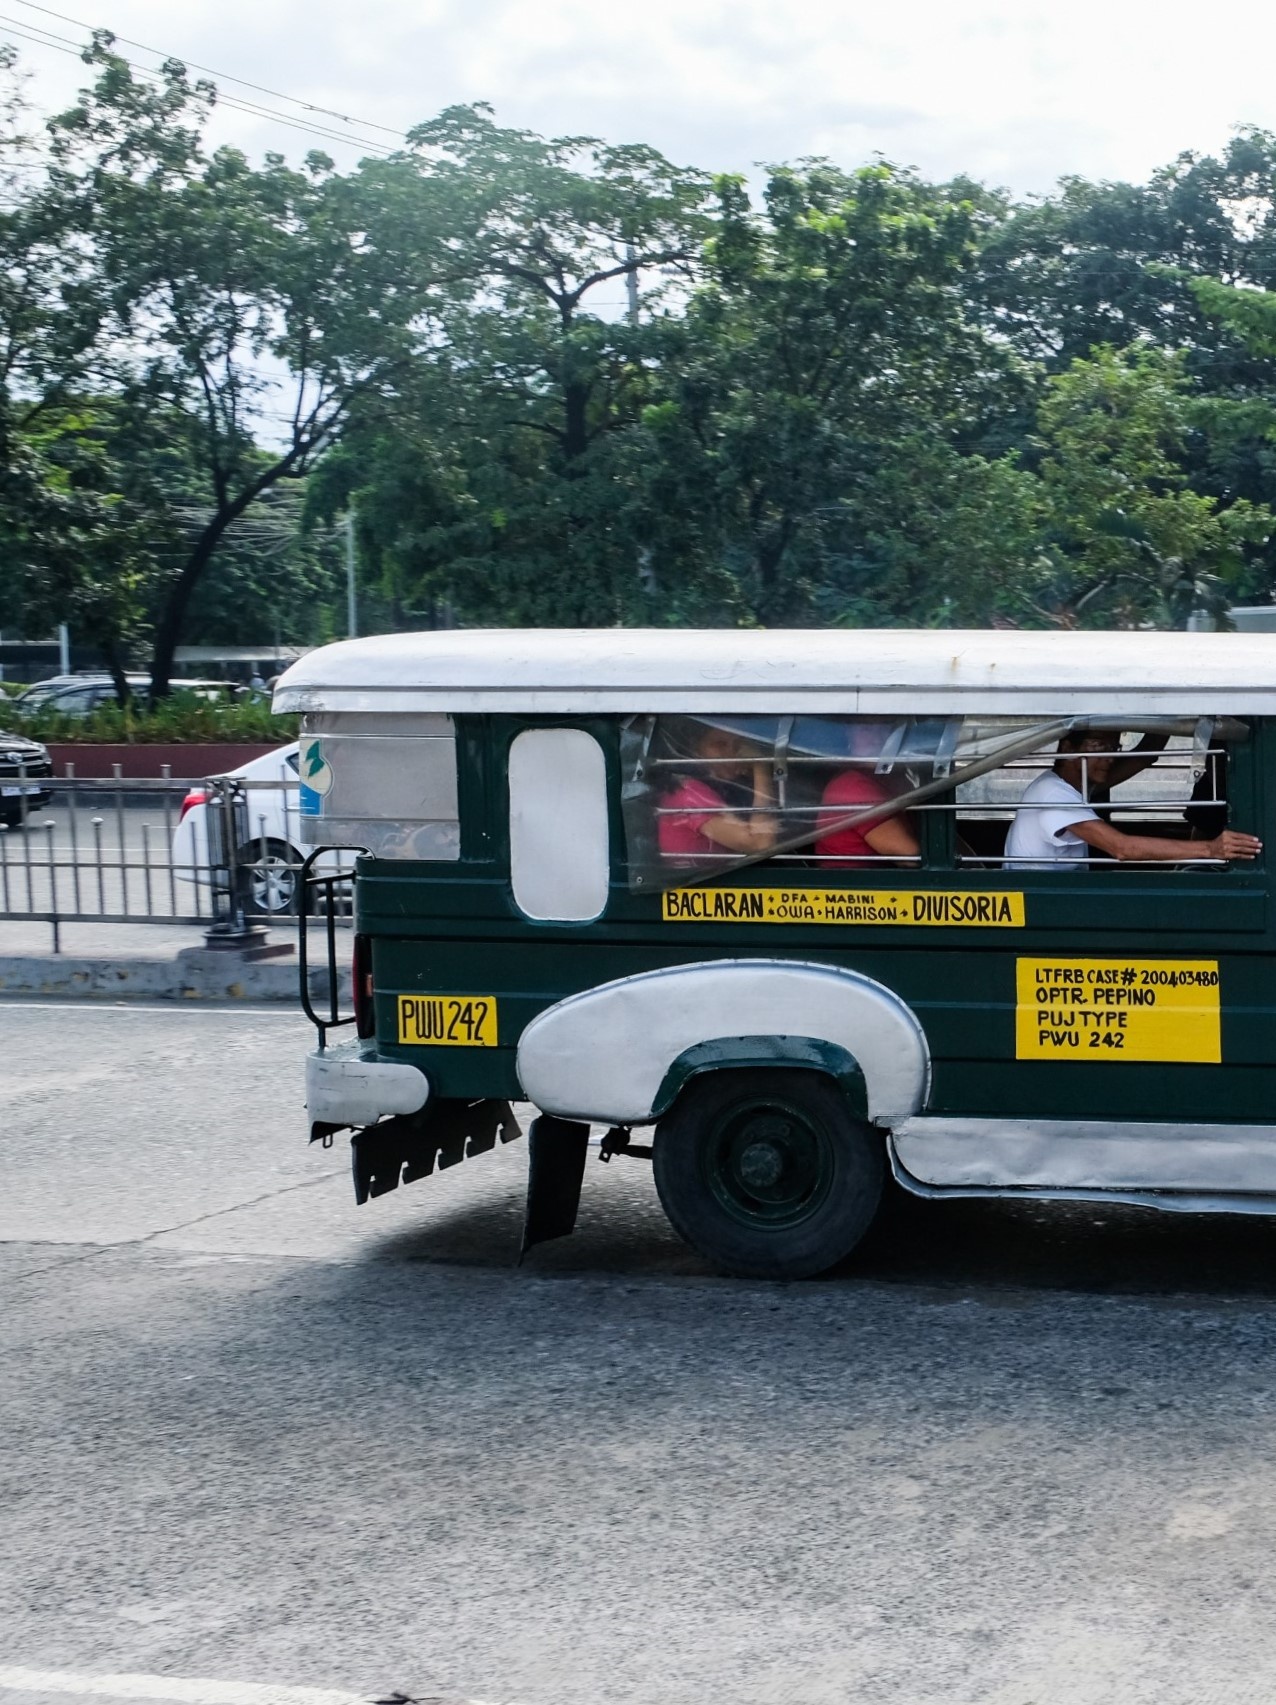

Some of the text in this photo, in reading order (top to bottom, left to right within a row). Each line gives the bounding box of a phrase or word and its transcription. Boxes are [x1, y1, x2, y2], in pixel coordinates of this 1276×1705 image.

[666, 892, 764, 918] BACLARAN
[781, 893, 875, 904] DFA MABINI
[825, 906, 897, 921] HARRISON
[912, 895, 1013, 922] DIVISORIA
[1035, 968, 1085, 984] LTFRB
[1141, 969, 1220, 987] 200403480
[1035, 987, 1156, 1006] OPTR. PEPINO
[401, 999, 488, 1041] PWU 242
[1037, 1010, 1128, 1028] PUJ TYPE
[1039, 1030, 1125, 1048] PWU 242
